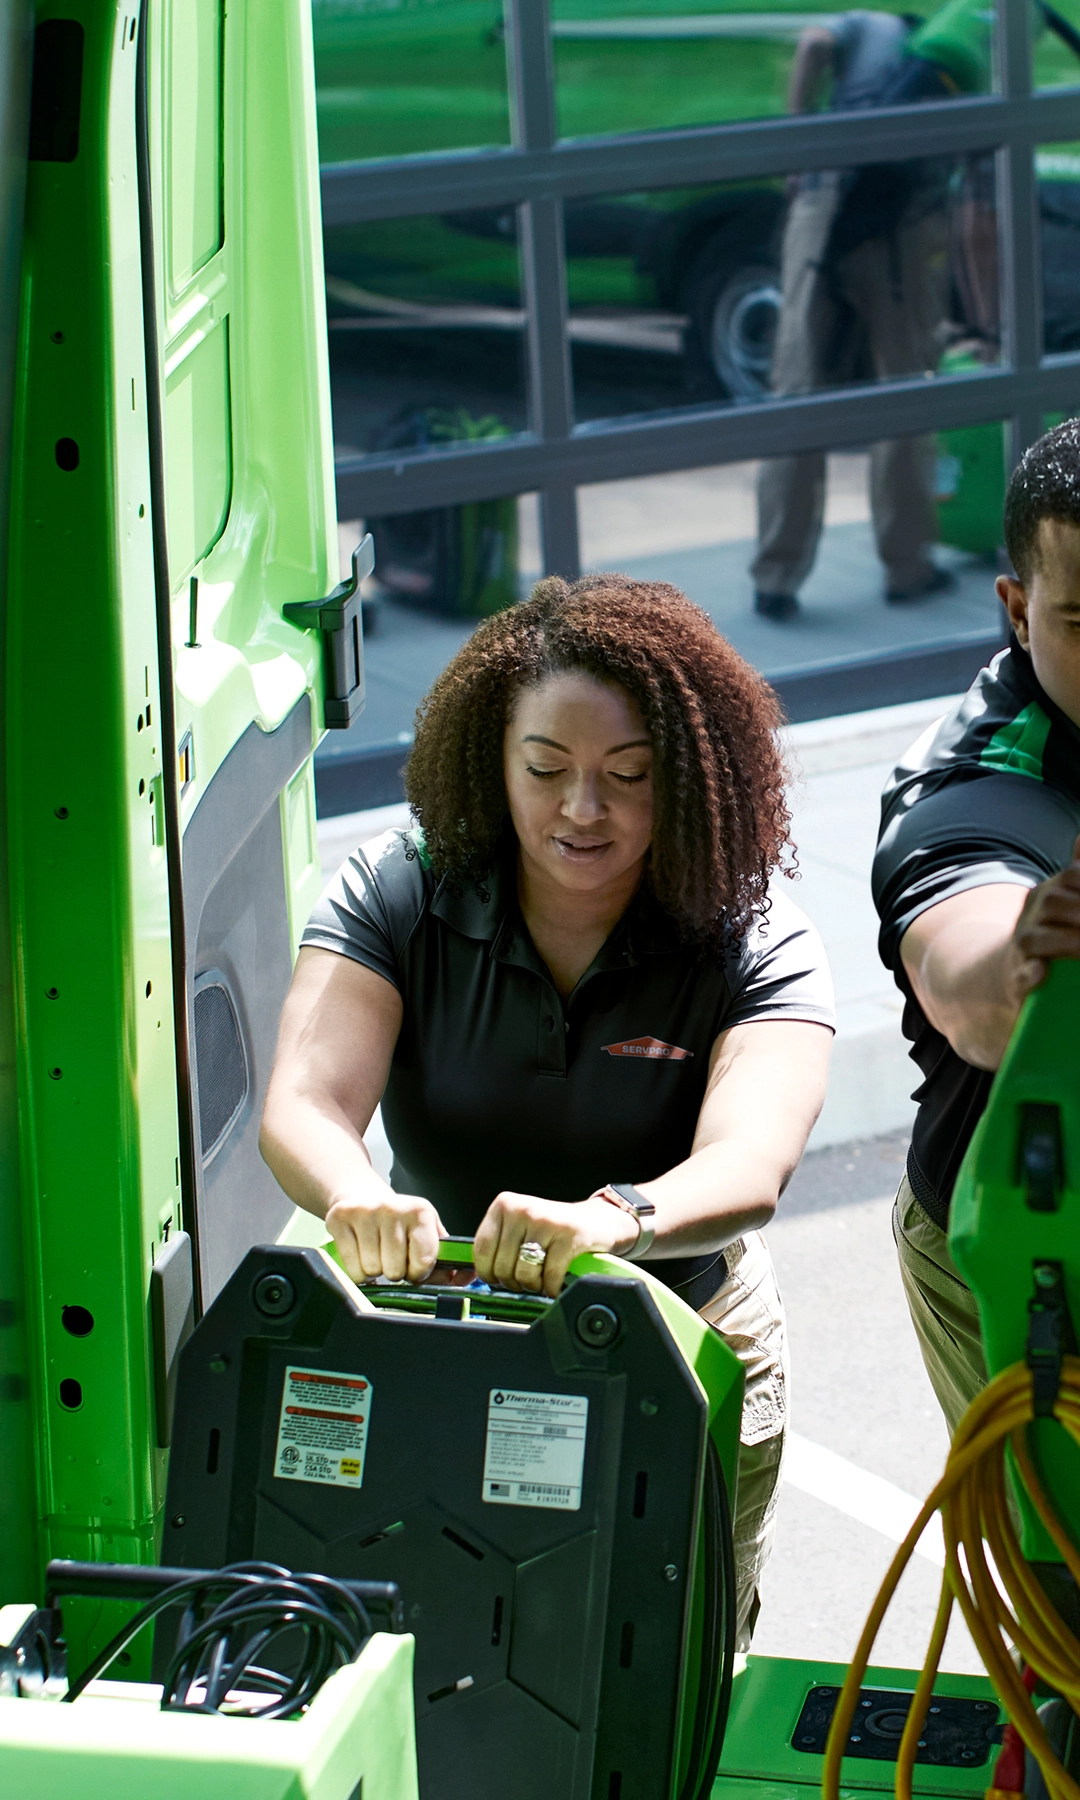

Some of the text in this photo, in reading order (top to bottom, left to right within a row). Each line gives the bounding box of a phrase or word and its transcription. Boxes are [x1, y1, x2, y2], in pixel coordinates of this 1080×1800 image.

[622, 1044, 671, 1056] SERVPRO
[505, 1394, 573, 1406] Therma-Stor
[319, 1466, 332, 1474] STD
